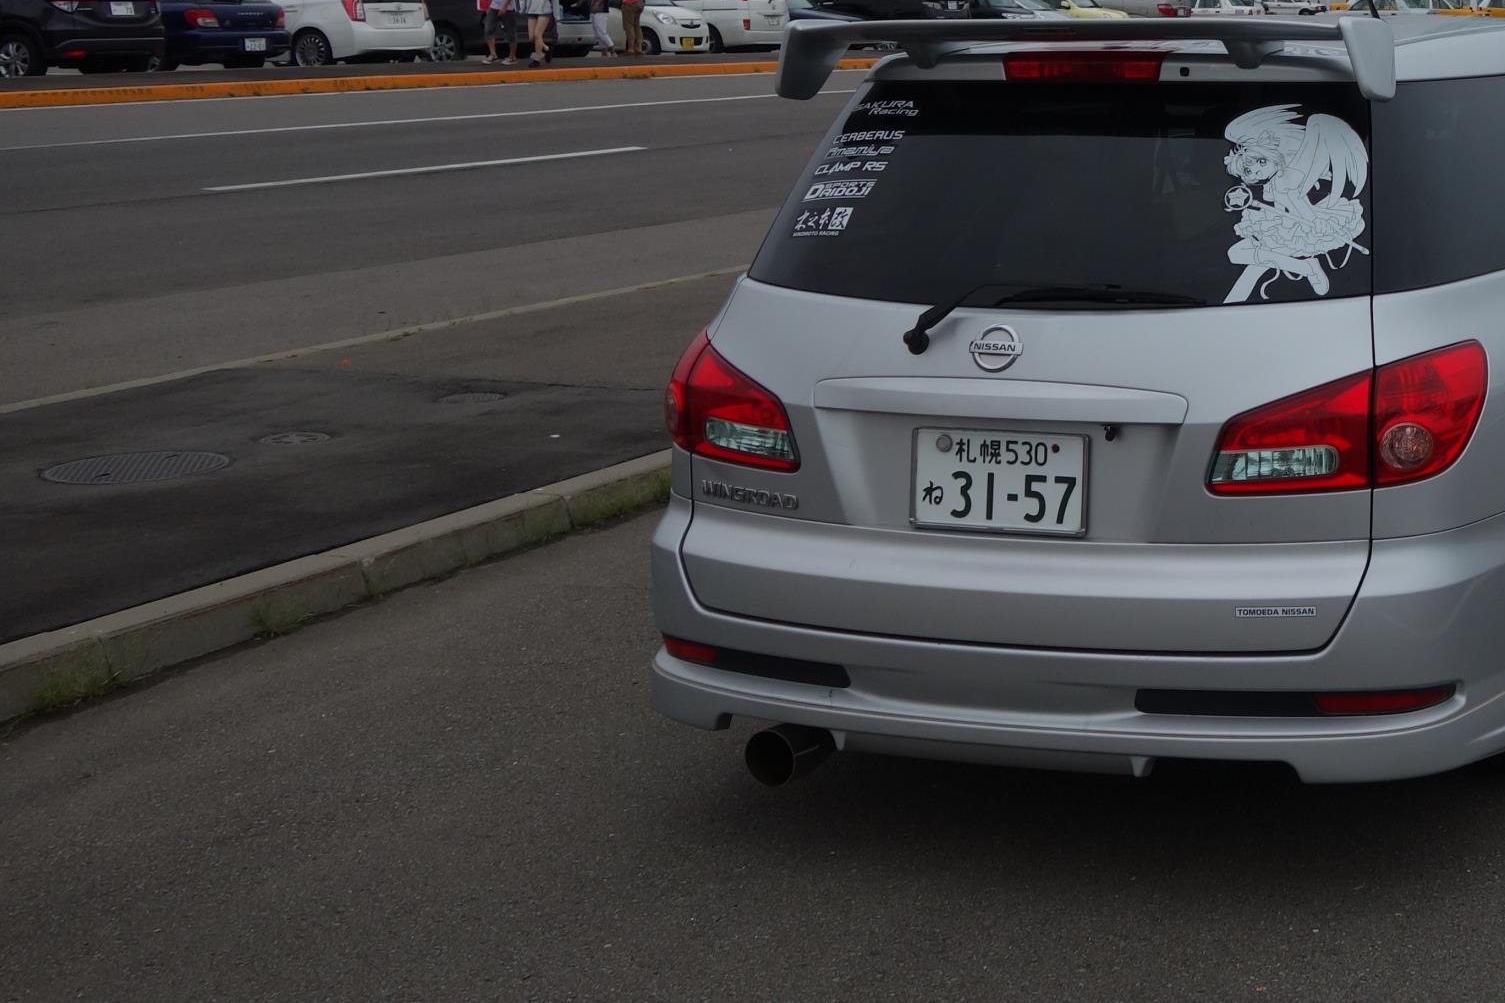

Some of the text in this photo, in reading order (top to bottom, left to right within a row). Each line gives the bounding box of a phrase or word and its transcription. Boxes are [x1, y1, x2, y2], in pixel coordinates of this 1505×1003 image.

[856, 100, 914, 111] SAKURA
[868, 107, 919, 116] Racing
[832, 130, 905, 144] CERBERUS
[814, 161, 888, 175] CLAMP RS
[804, 185, 872, 199] DAIDOJI
[973, 342, 1016, 353] NISSAN
[922, 470, 1077, 525] ね 31-57
[1237, 608, 1279, 616] TOMOEDA
